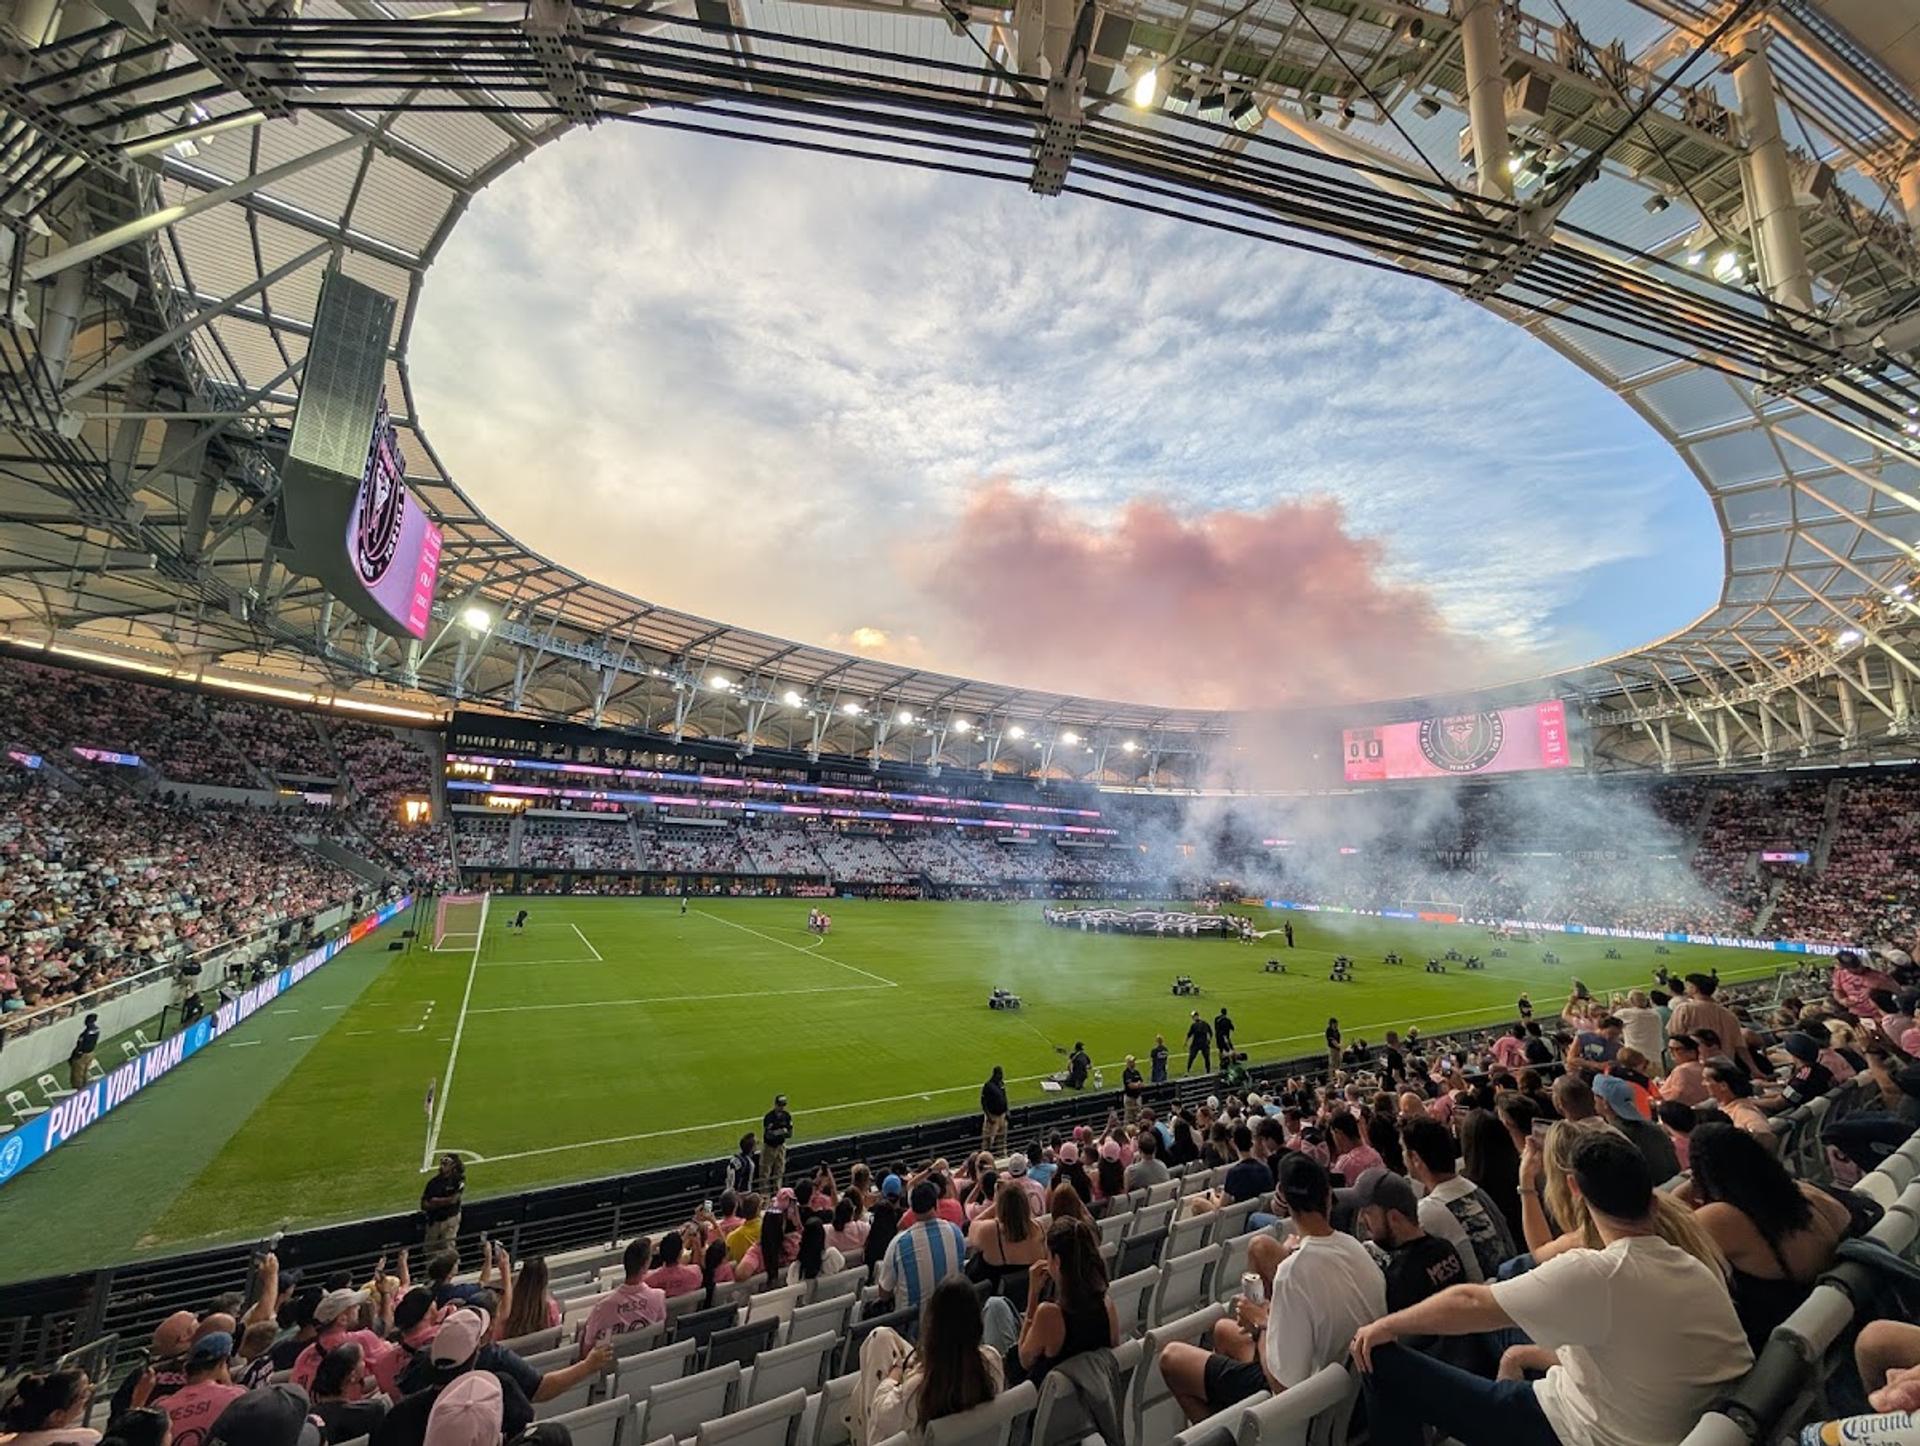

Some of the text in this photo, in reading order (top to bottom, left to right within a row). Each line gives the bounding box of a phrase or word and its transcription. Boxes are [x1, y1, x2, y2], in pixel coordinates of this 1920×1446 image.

[1370, 742, 1379, 756] 0
[1583, 925, 1664, 941] PURA VIDA MIAMI
[1687, 934, 1775, 950] PURA VIDA MIAMI
[1805, 943, 1839, 955] PURA
[44, 1031, 187, 1153] PURA VIDA MIAMI
[617, 1298, 648, 1314] MESSI
[1842, 1413, 1913, 1440] Corona
